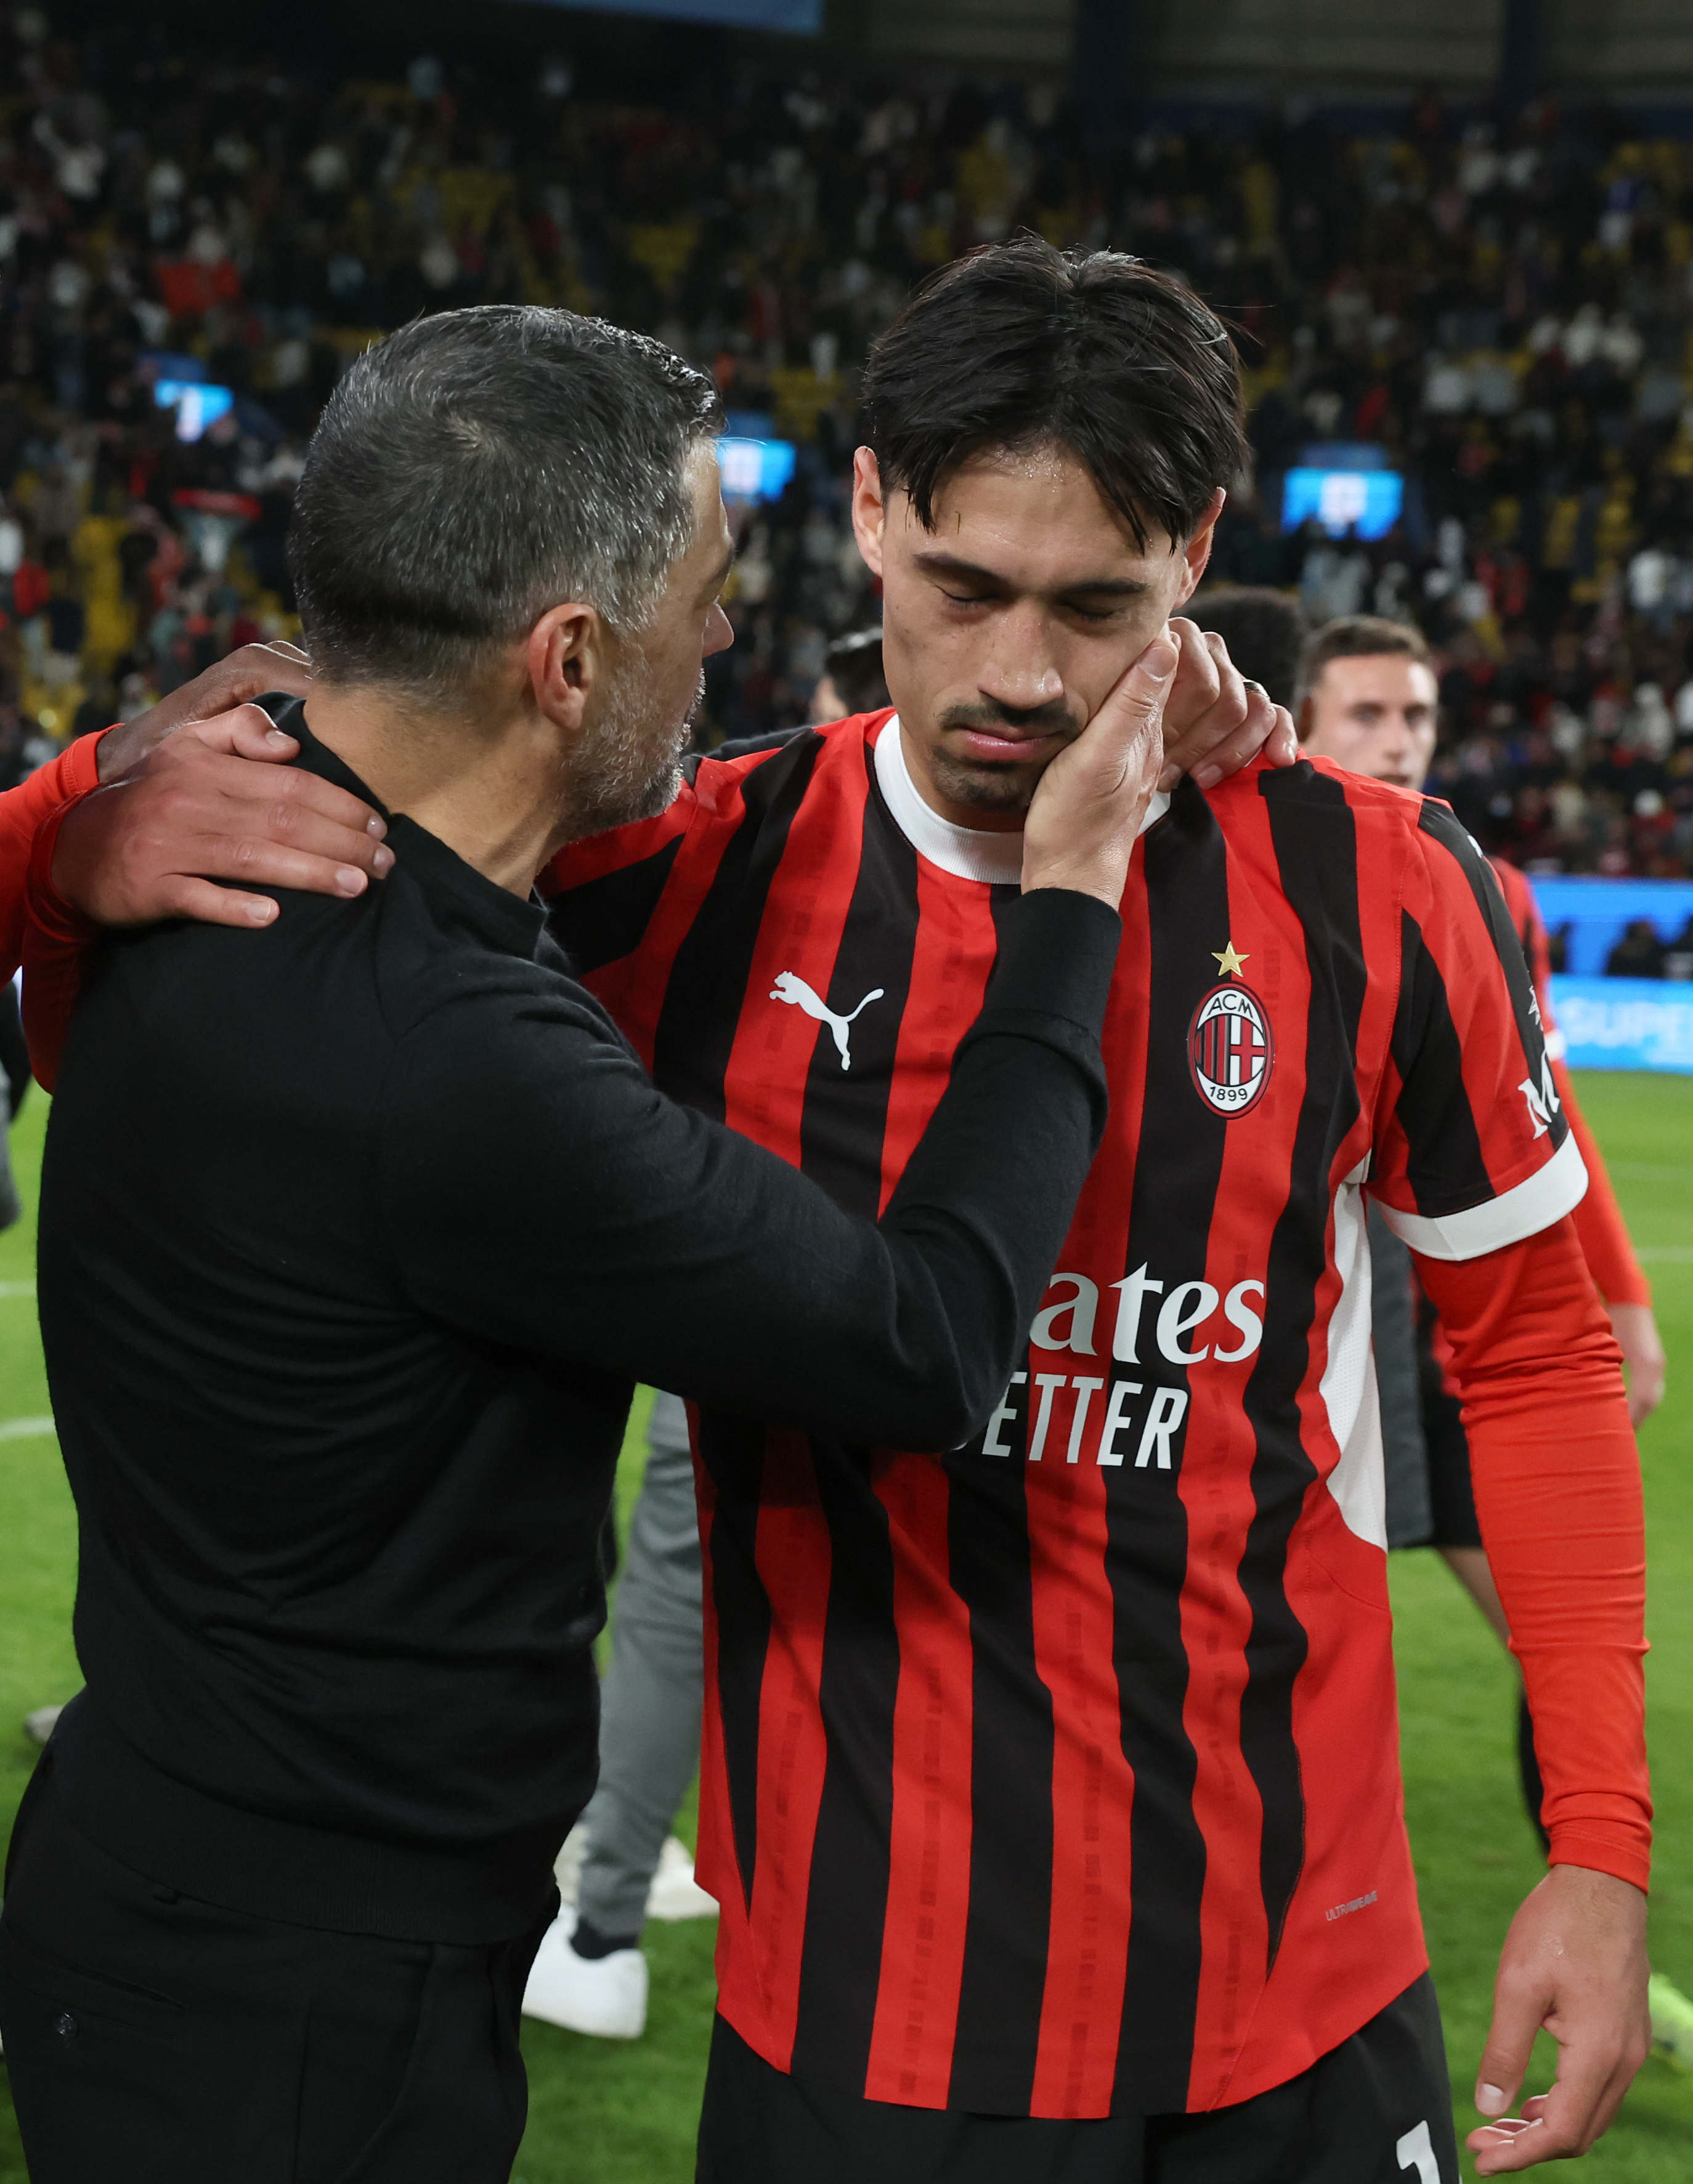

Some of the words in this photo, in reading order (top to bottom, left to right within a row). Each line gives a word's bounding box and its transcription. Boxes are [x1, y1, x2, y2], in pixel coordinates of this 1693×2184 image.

[1206, 993, 1254, 1019] ACM
[1209, 1086, 1248, 1102] 1899
[952, 1371, 1188, 1470] ETTER
